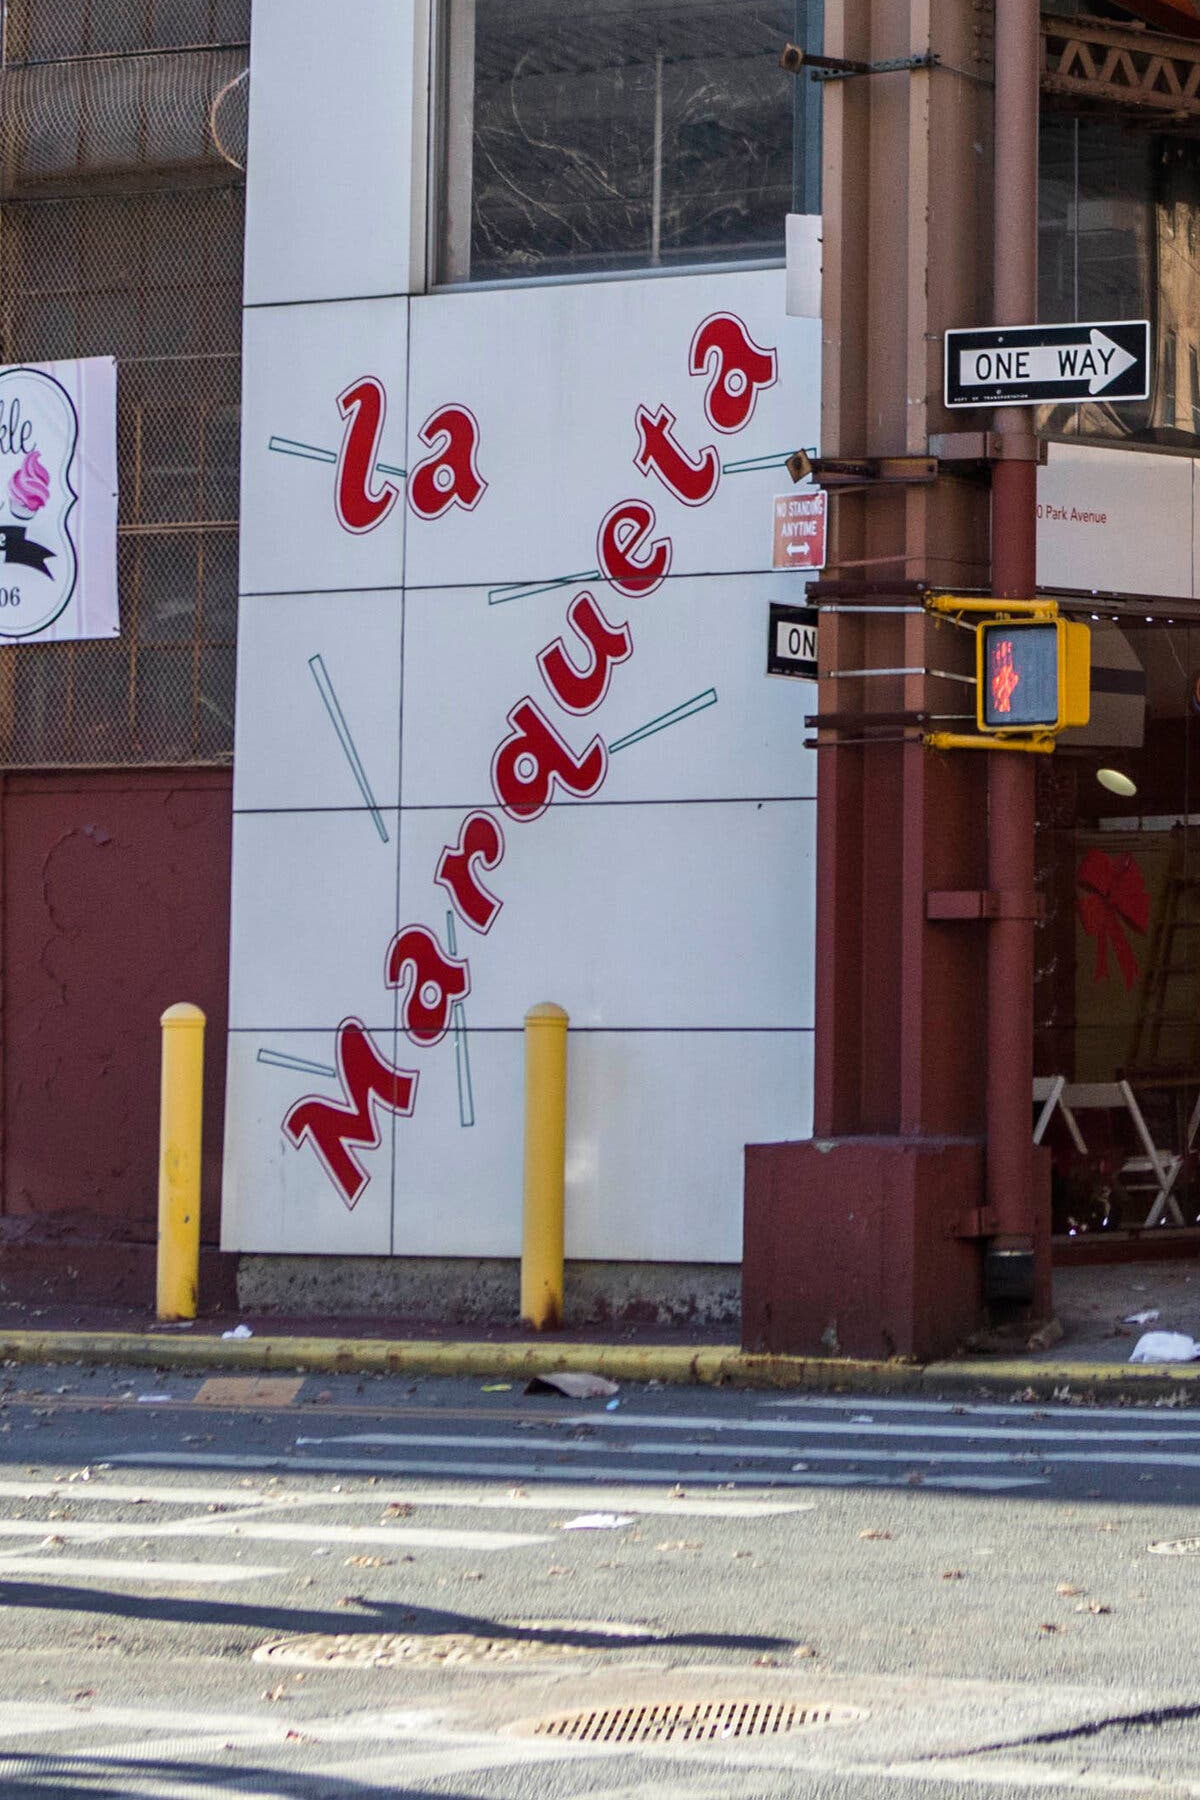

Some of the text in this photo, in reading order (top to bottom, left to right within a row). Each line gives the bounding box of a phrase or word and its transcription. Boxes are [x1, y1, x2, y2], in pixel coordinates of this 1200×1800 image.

[975, 348, 1116, 380] ONE WAY
[776, 498, 823, 518] NO STANDING
[1046, 505, 1067, 520] Park
[1070, 507, 1107, 524] Avenue
[781, 520, 817, 537] ANYTIME
[283, 311, 778, 1211] Marqueta
